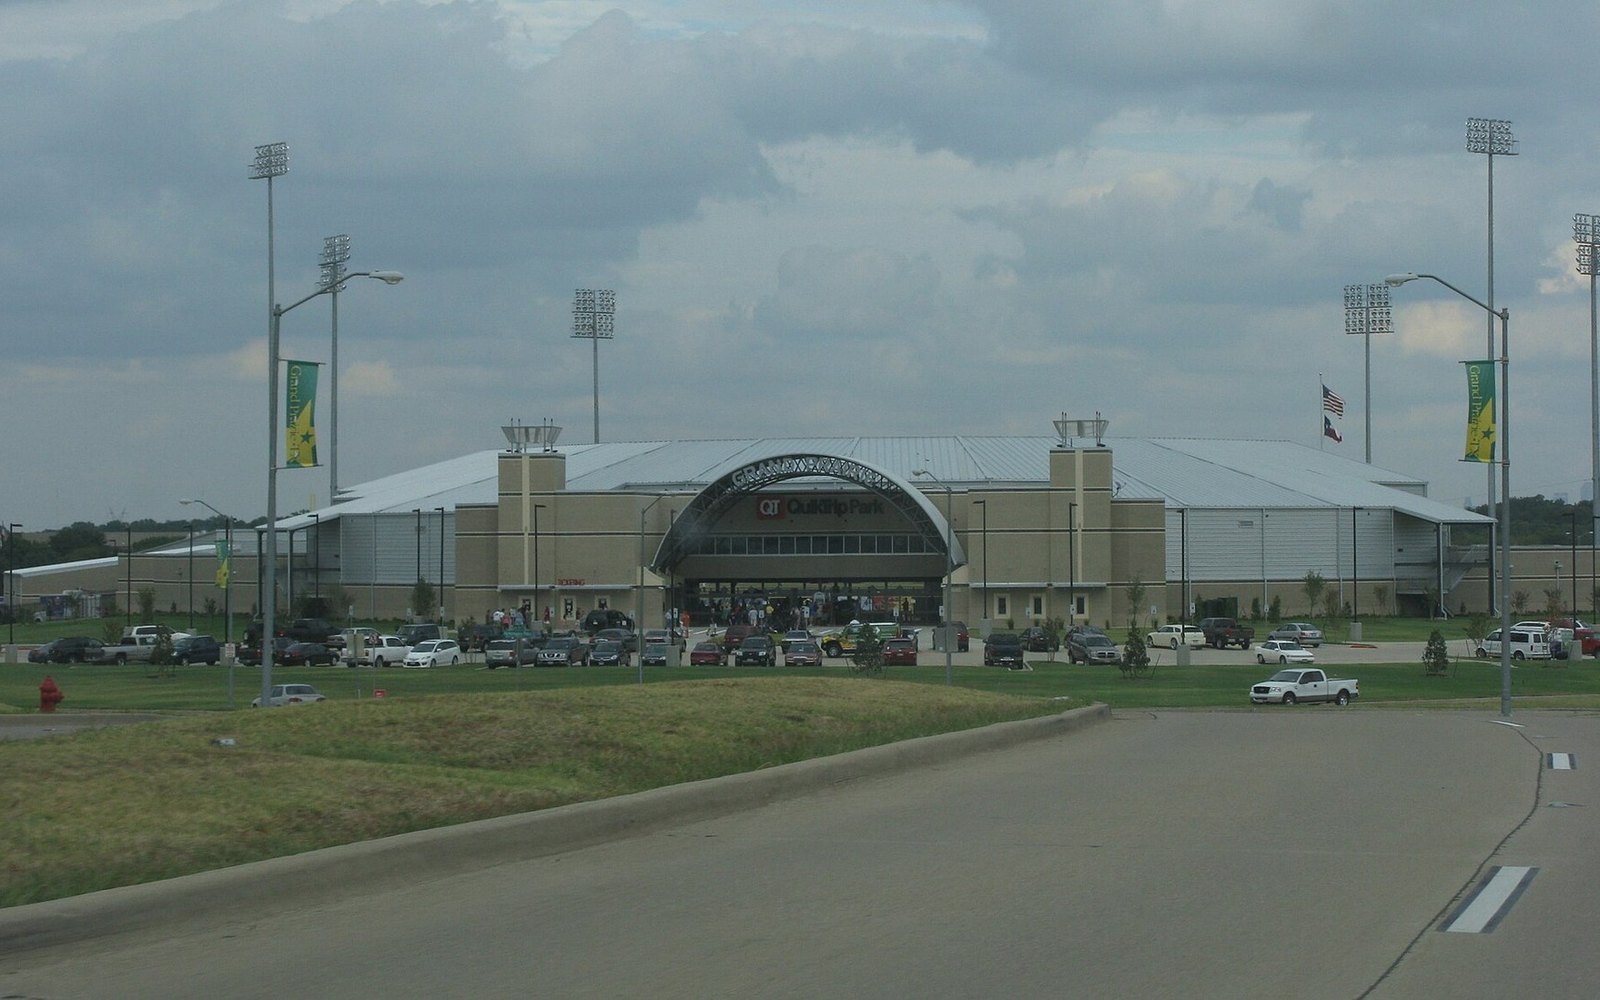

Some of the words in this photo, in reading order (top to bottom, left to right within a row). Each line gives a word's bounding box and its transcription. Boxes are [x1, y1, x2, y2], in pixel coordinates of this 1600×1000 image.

[290, 365, 301, 403] Grand
[1470, 365, 1482, 400] Grand
[732, 457, 795, 487] GRAND
[805, 456, 877, 488] PRAIRIE
[760, 499, 781, 516] QT
[849, 498, 884, 514] Park
